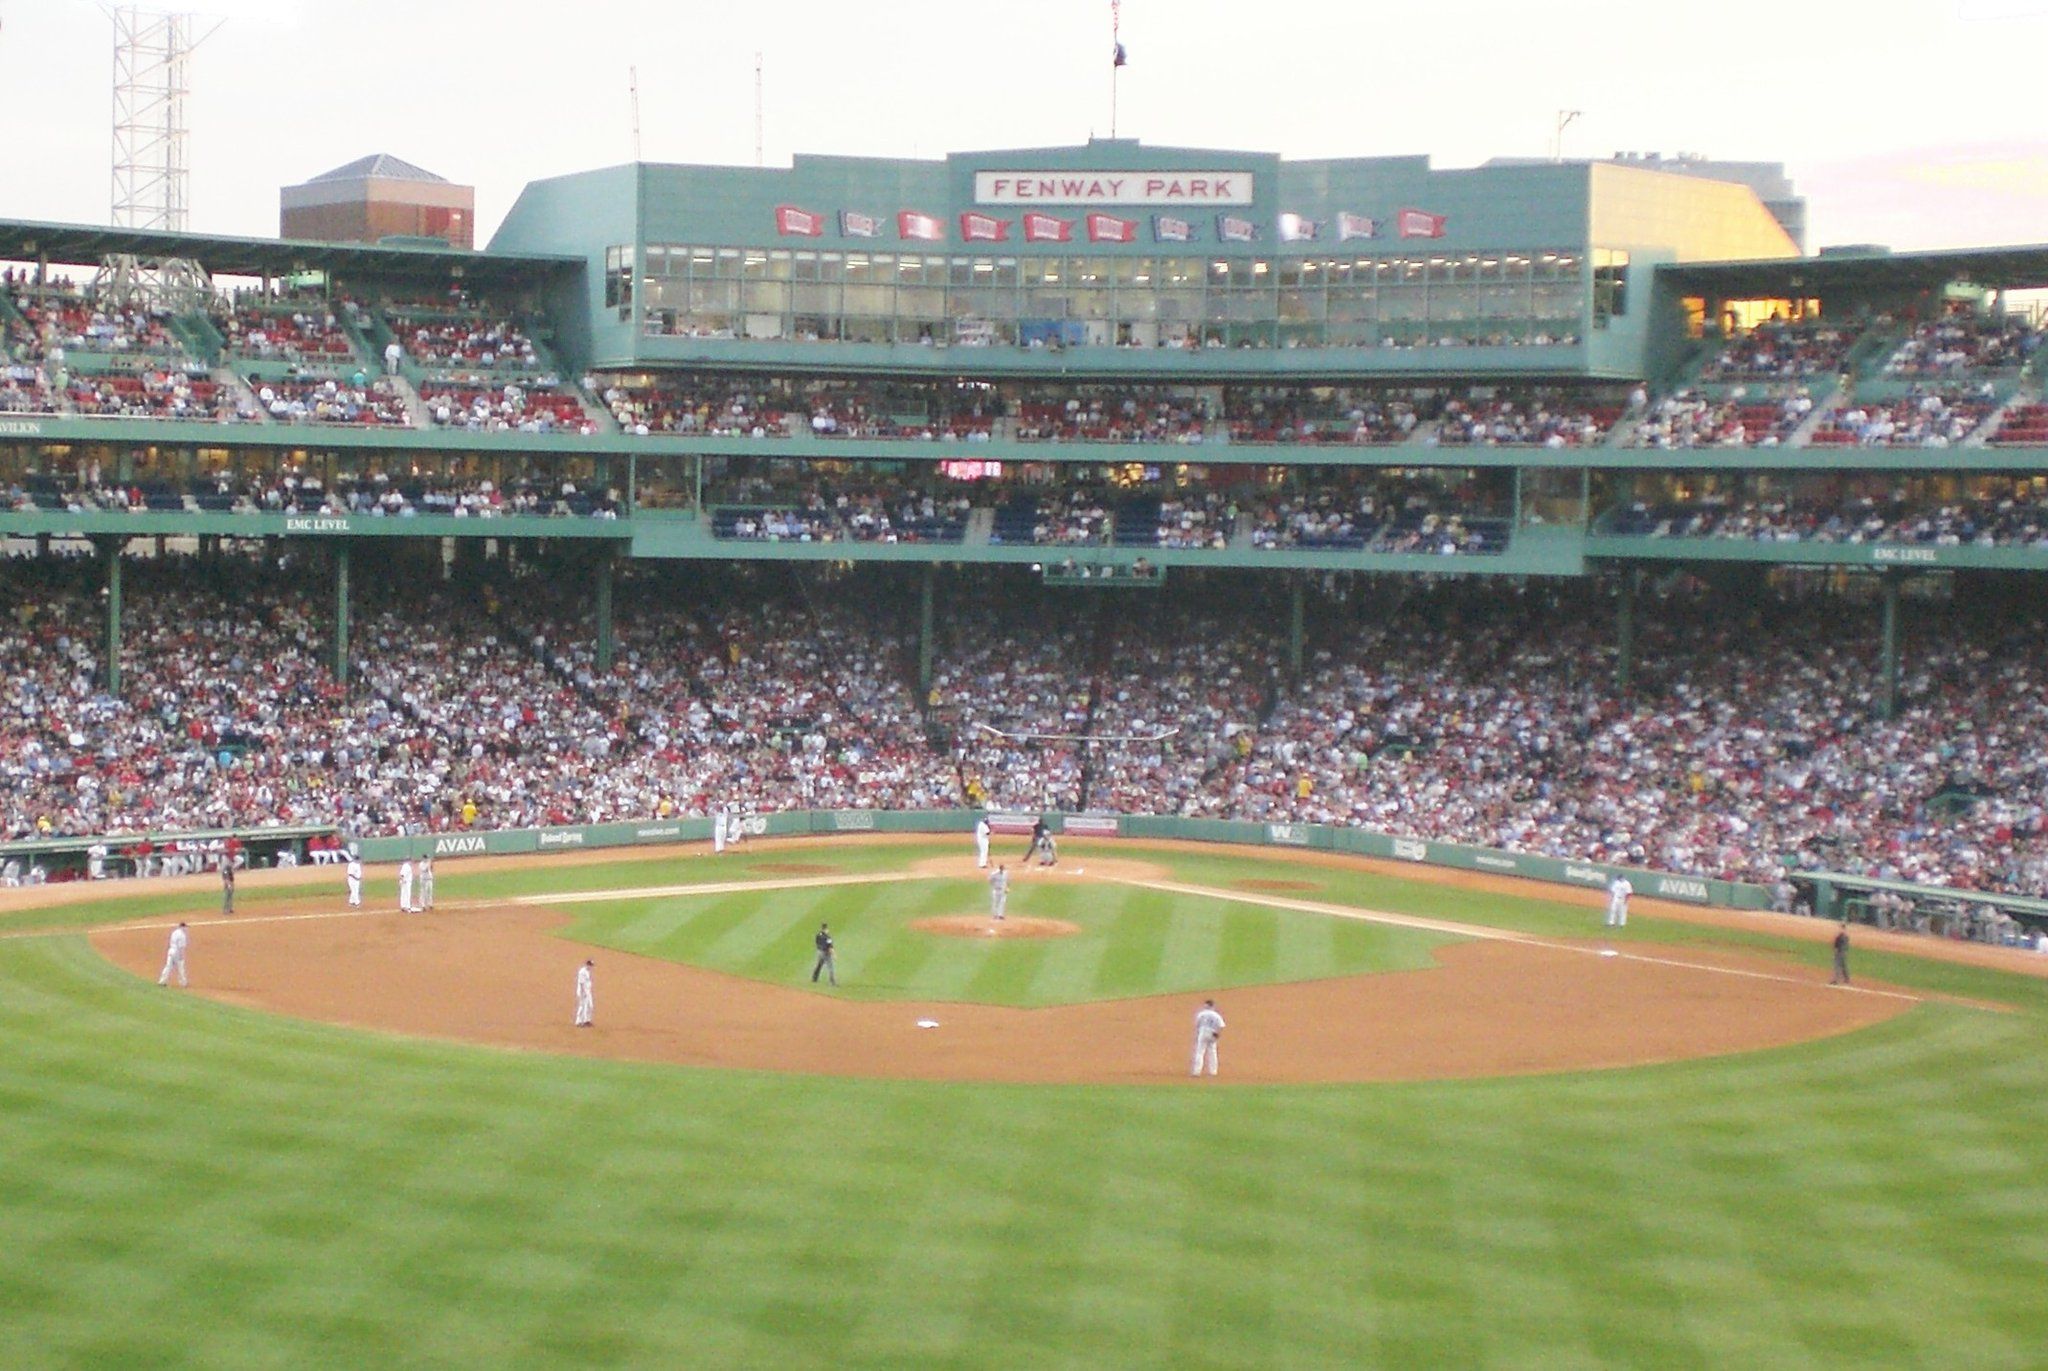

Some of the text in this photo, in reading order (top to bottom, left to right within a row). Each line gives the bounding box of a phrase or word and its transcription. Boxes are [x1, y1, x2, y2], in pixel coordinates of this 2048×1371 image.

[994, 179, 1231, 197] FENWAY PARK
[0, 422, 41, 433] VILION
[287, 519, 350, 530] EMC LEVEL
[1901, 549, 1937, 561] LEVEL
[435, 837, 486, 853] AVAYA
[1659, 879, 1709, 898] AVAYA
